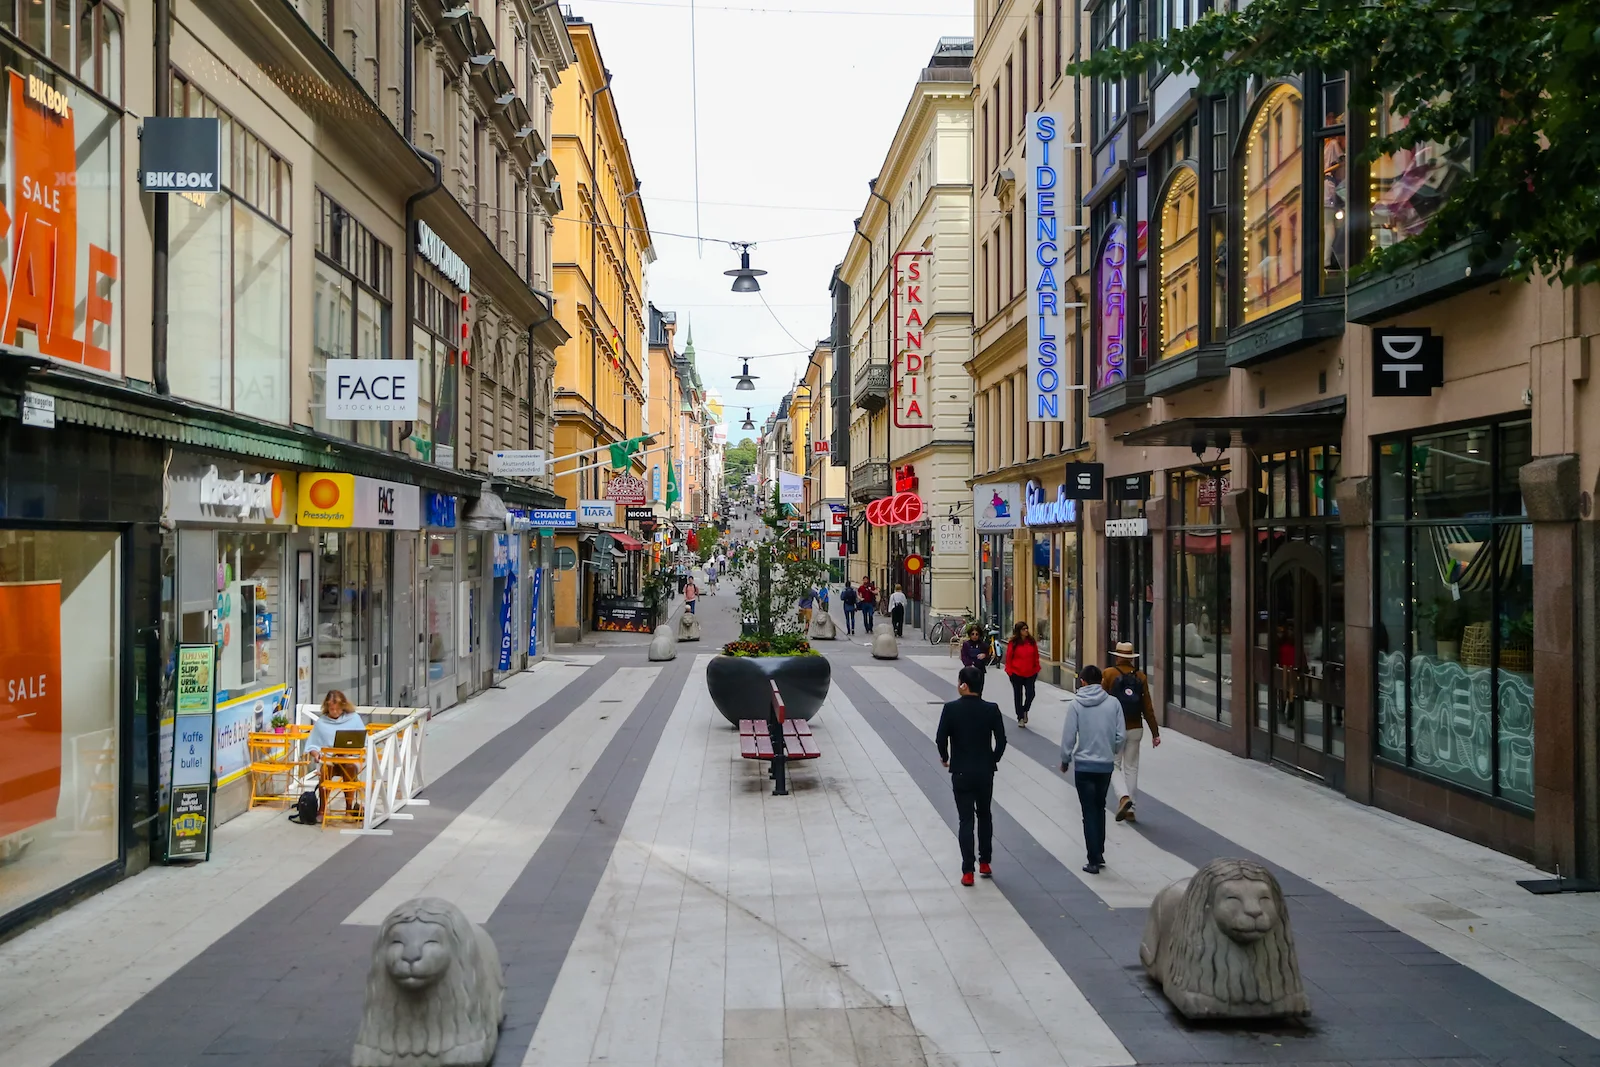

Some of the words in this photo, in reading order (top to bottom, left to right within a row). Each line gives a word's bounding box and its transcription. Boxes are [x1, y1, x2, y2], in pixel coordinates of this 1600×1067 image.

[23, 176, 60, 214] SALE
[1036, 116, 1058, 418] SIDENCARLSON
[0, 203, 117, 371] ALE
[905, 262, 922, 418] SKANDIA
[338, 376, 405, 400] FACE
[303, 510, 344, 520] Pressbyrån
[534, 511, 572, 519] CHANGE
[941, 524, 962, 532] CITY
[8, 674, 46, 703] SALE
[182, 732, 203, 742] Kaffe
[189, 745, 195, 754] &
[181, 757, 202, 768] bulle!
